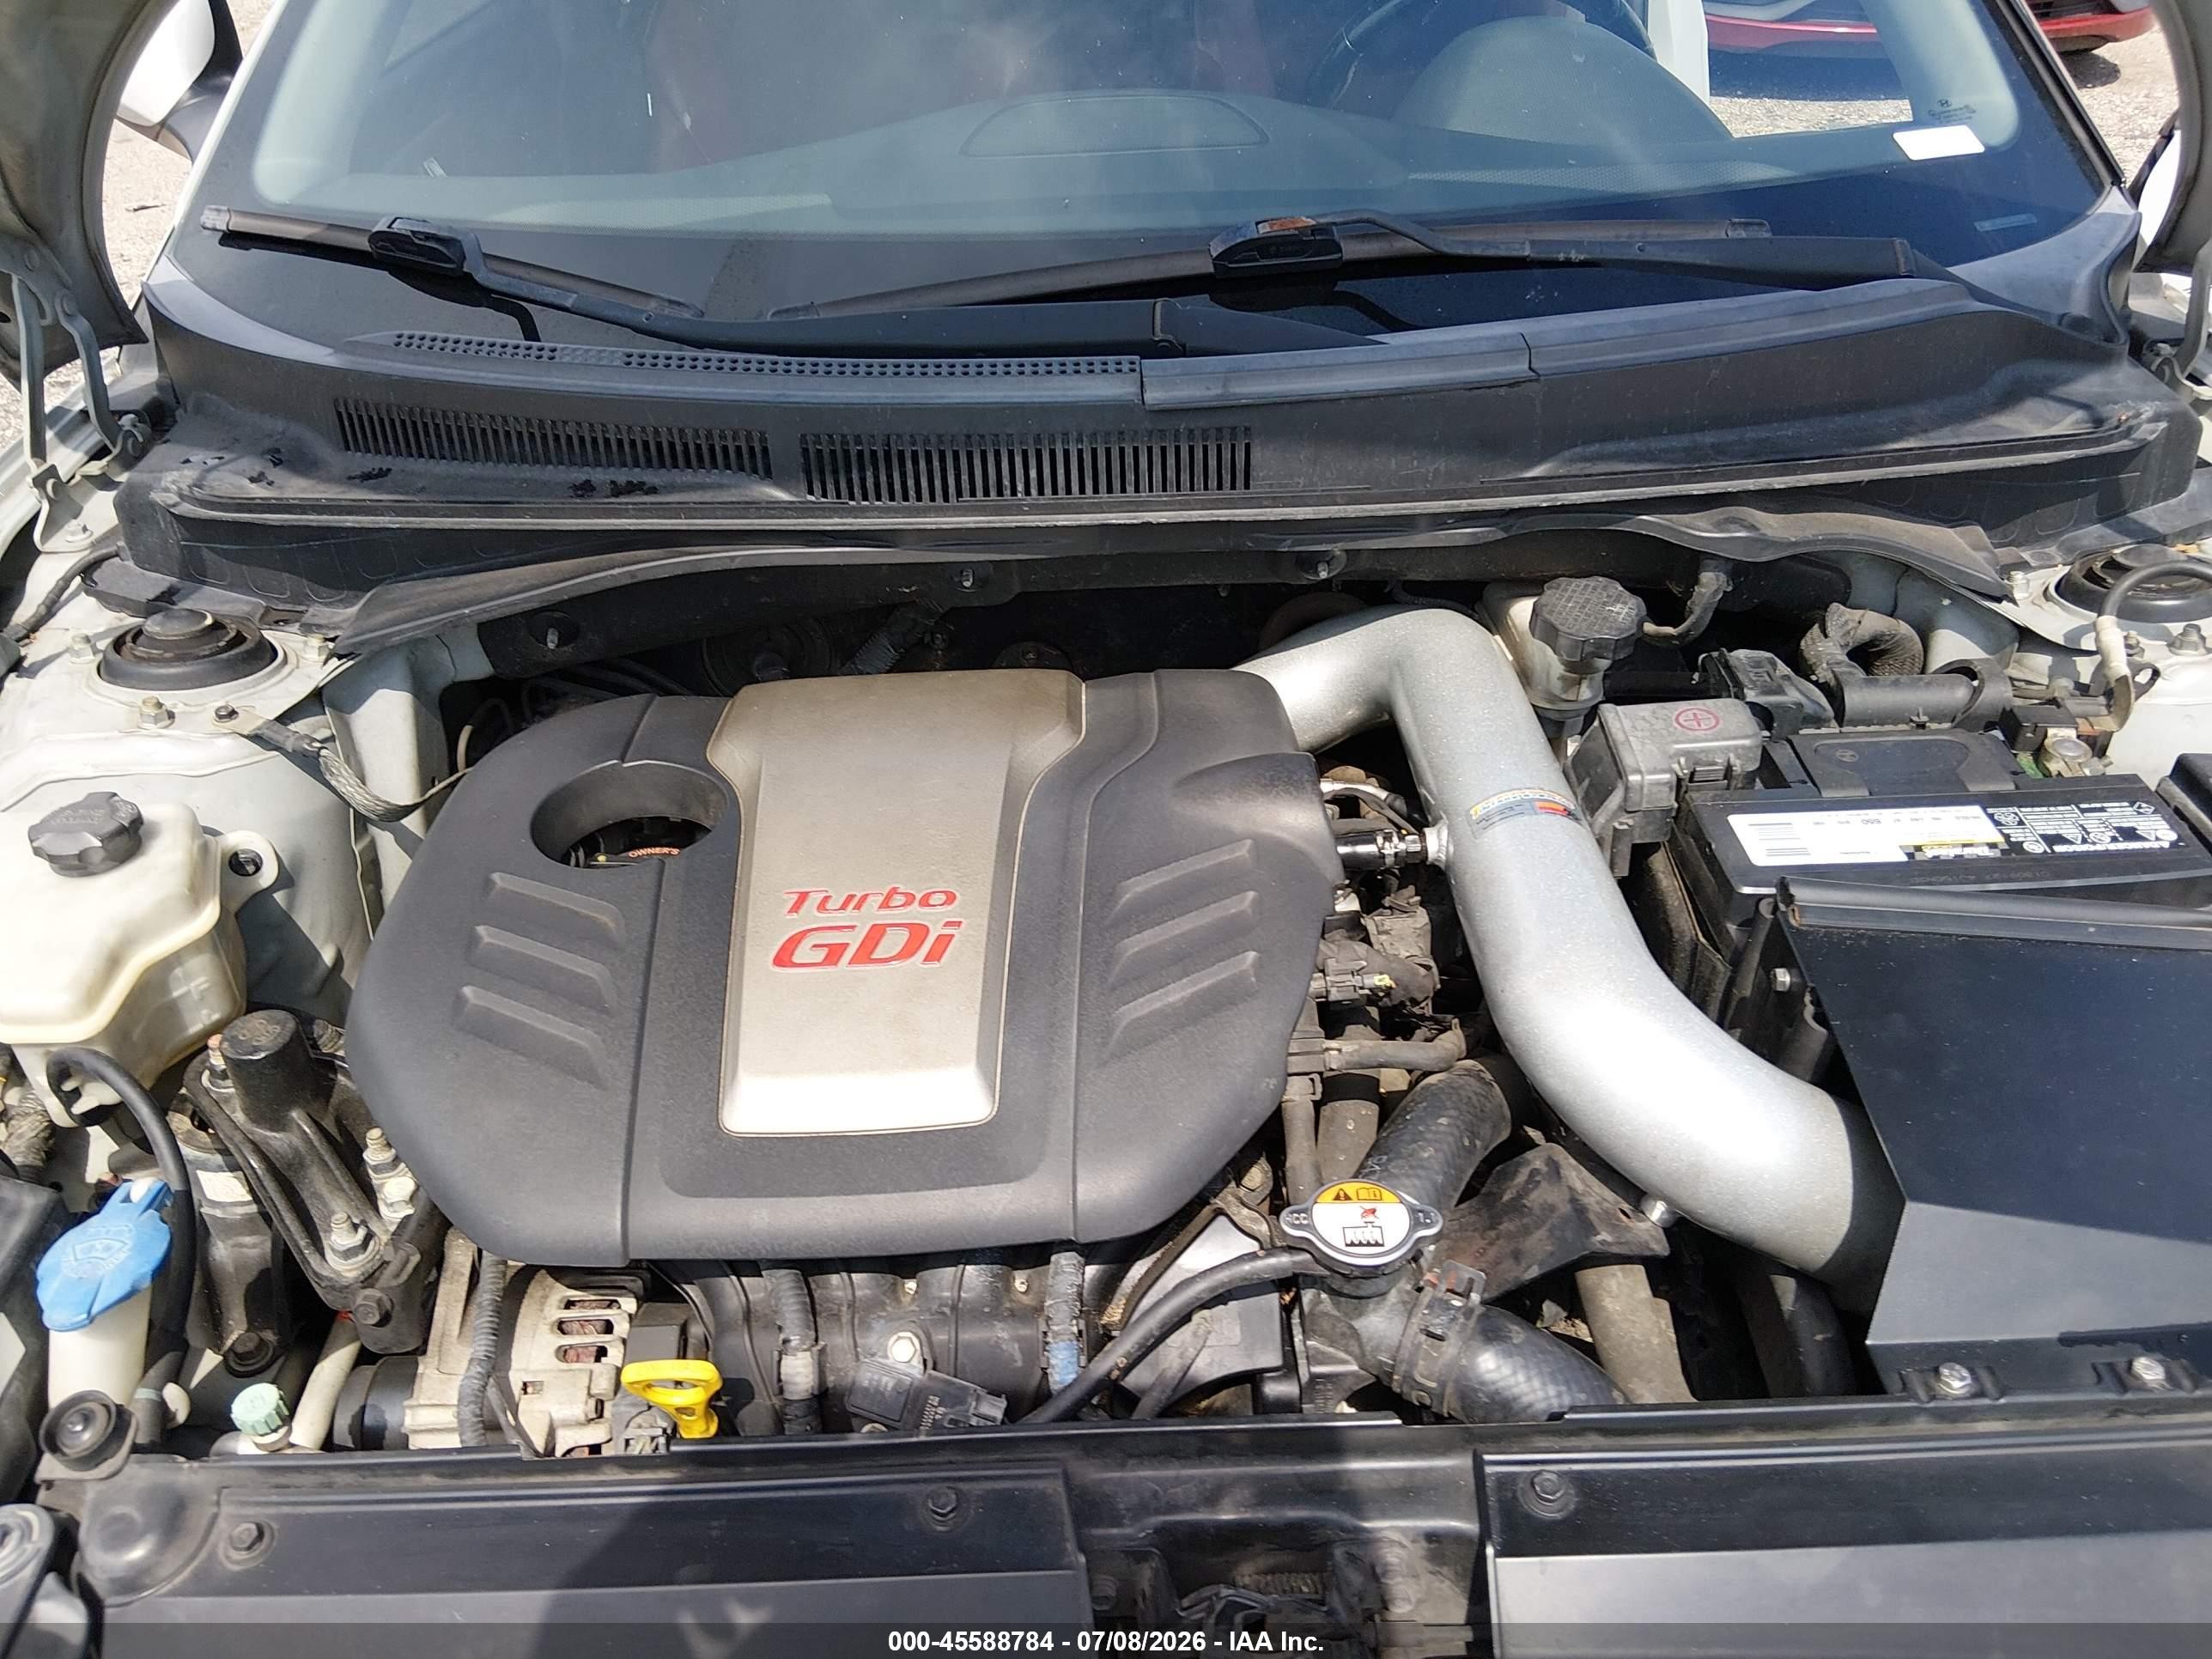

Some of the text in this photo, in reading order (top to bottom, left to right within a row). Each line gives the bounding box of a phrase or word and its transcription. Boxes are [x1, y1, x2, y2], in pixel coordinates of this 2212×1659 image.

[628, 847, 681, 859] OWNER'S
[783, 886, 958, 918] Turbo
[770, 919, 964, 972] GDi
